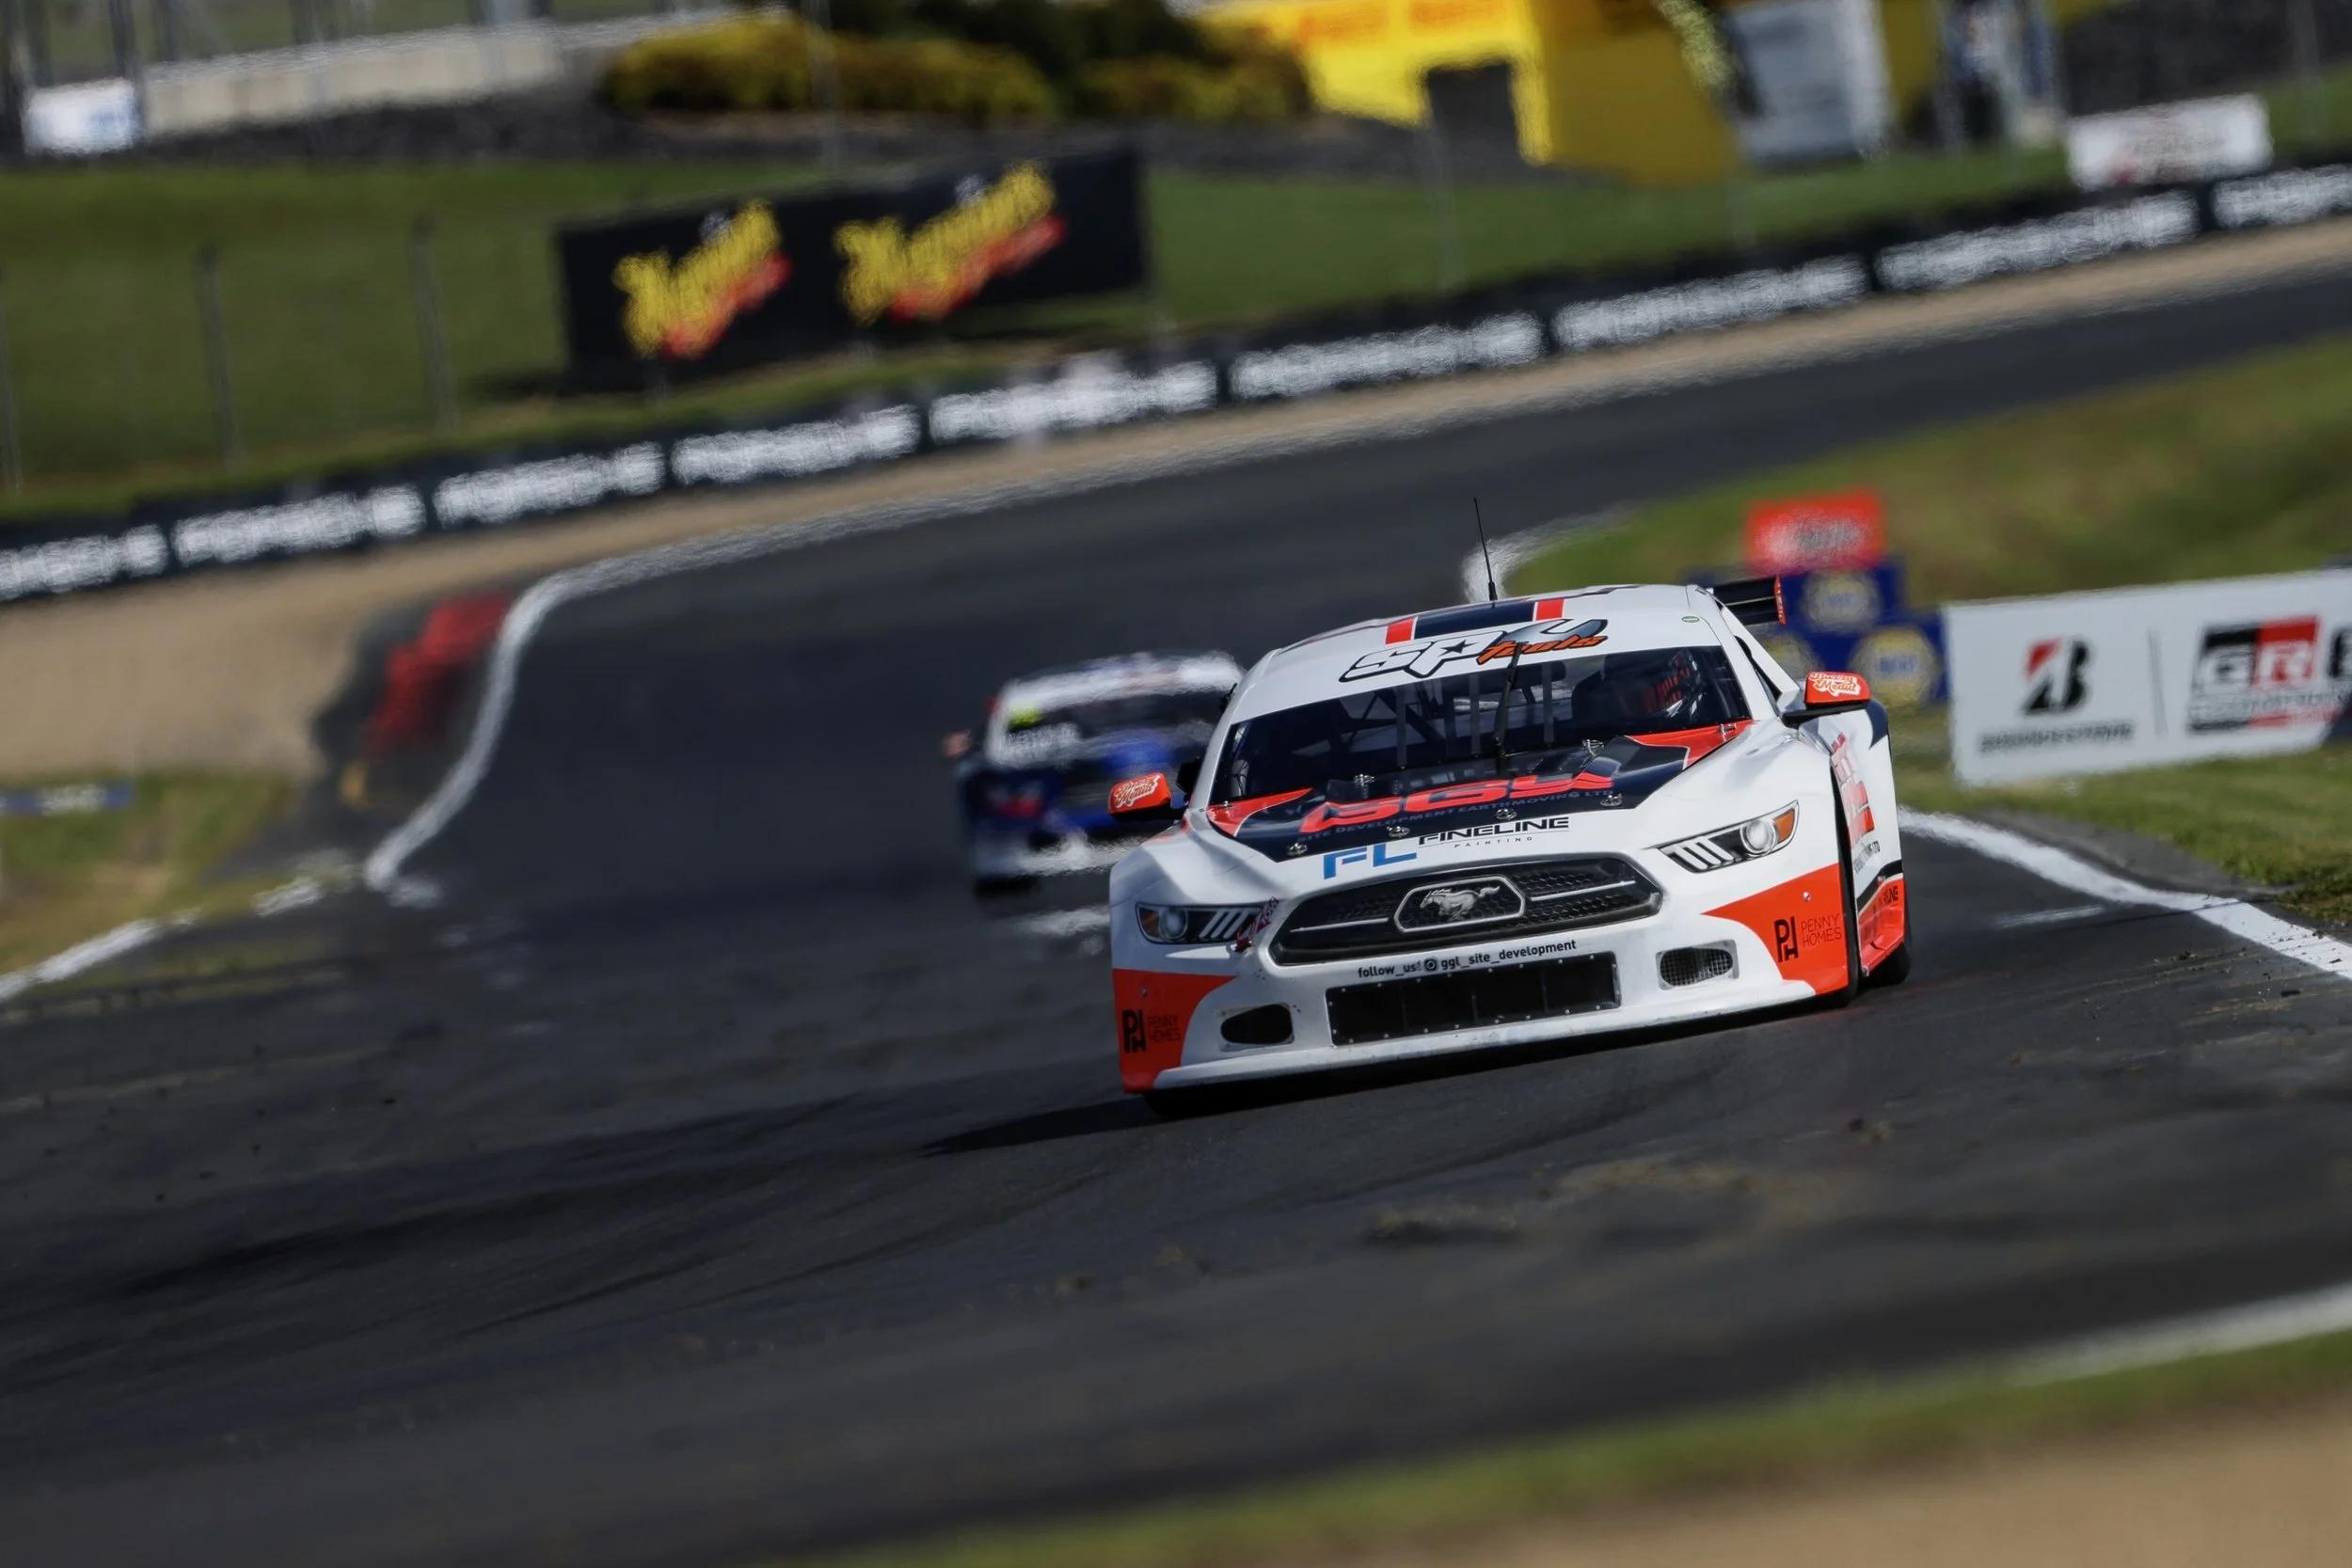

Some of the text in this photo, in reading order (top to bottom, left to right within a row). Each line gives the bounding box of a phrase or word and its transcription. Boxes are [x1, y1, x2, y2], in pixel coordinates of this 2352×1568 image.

[1335, 809, 1455, 834] DEVELOPMENT
[1418, 816, 1569, 846] FINELINE
[1454, 836, 1533, 848] PAINTING
[1801, 912, 1840, 934] PENNY
[1803, 927, 1843, 948] HOMES
[1440, 939, 1577, 972] ggl_site_development
